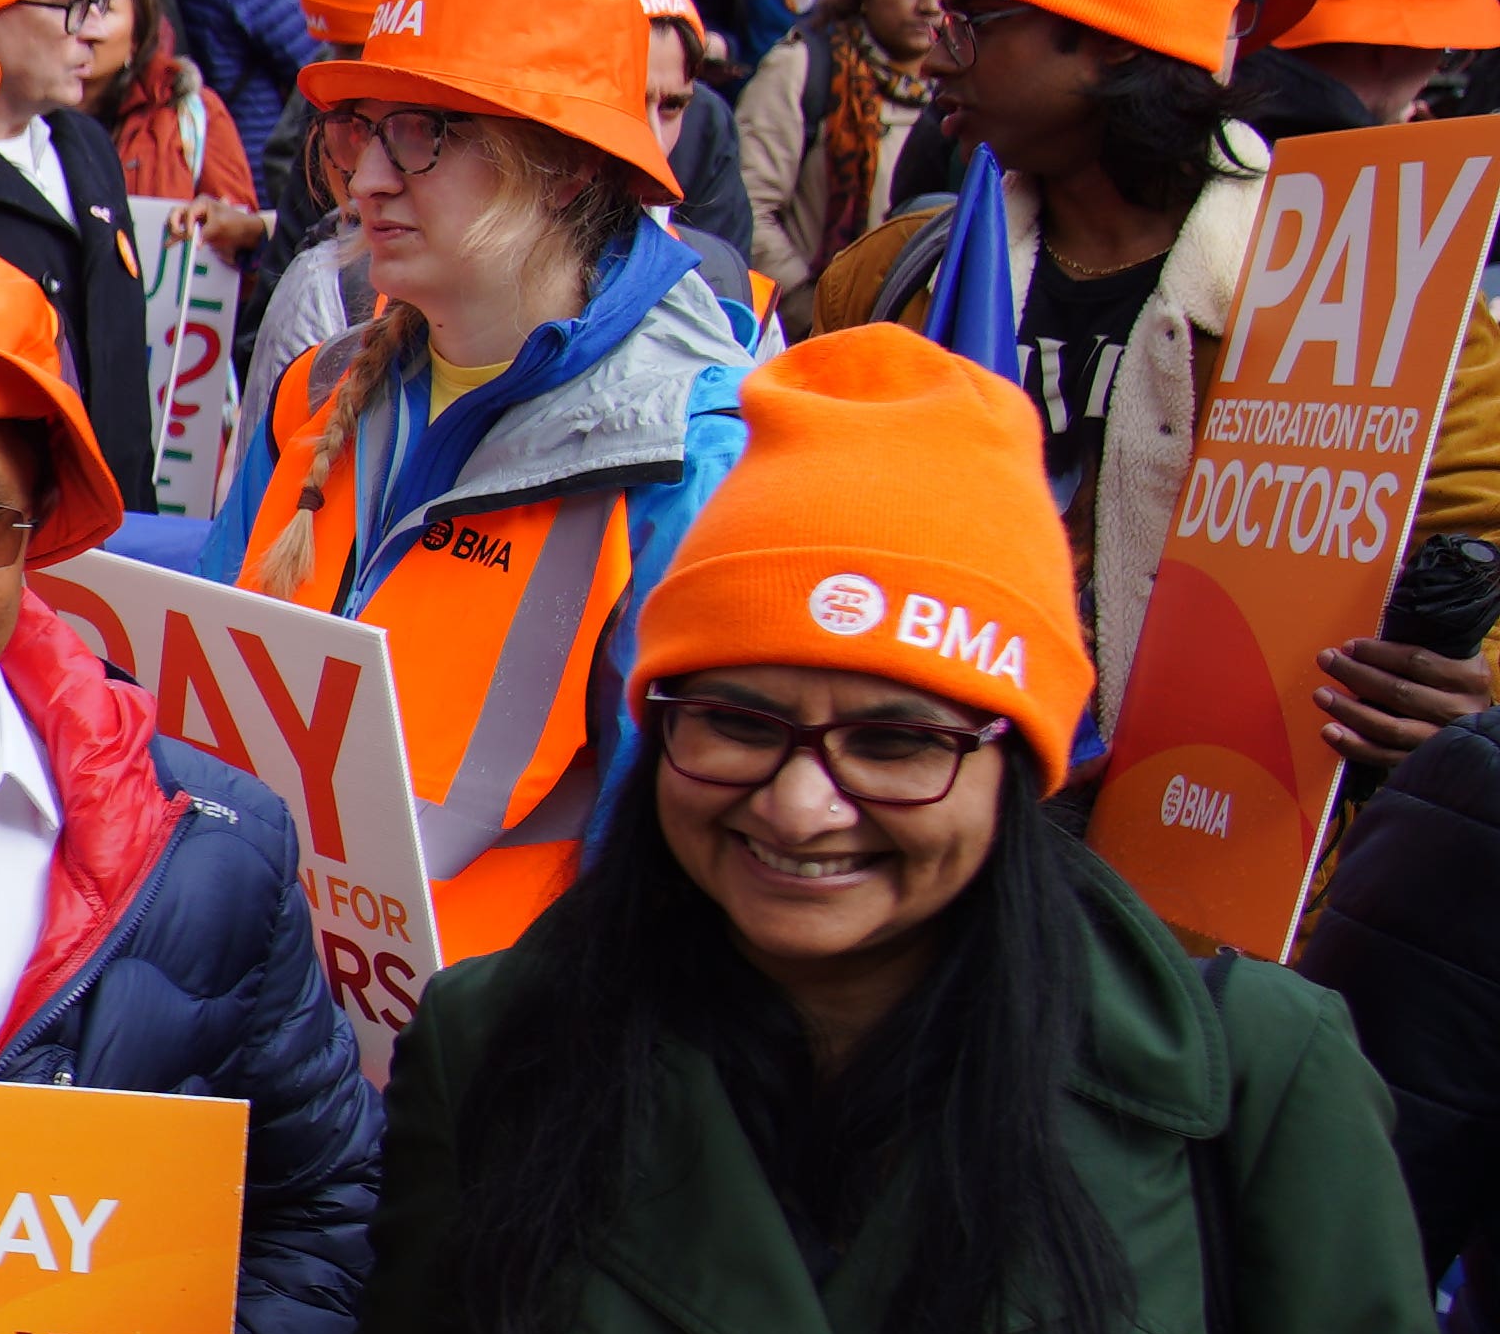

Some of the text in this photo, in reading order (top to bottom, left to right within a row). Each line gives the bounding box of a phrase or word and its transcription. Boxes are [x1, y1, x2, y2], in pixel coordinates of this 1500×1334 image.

[1221, 155, 1491, 388] PAY
[1203, 399, 1419, 455] RESTORATION FOR
[1177, 458, 1399, 564] DOCTORS
[451, 526, 510, 572] BMA
[896, 593, 1026, 690] BMA
[1180, 787, 1231, 839] BMA
[327, 874, 411, 945] FOR
